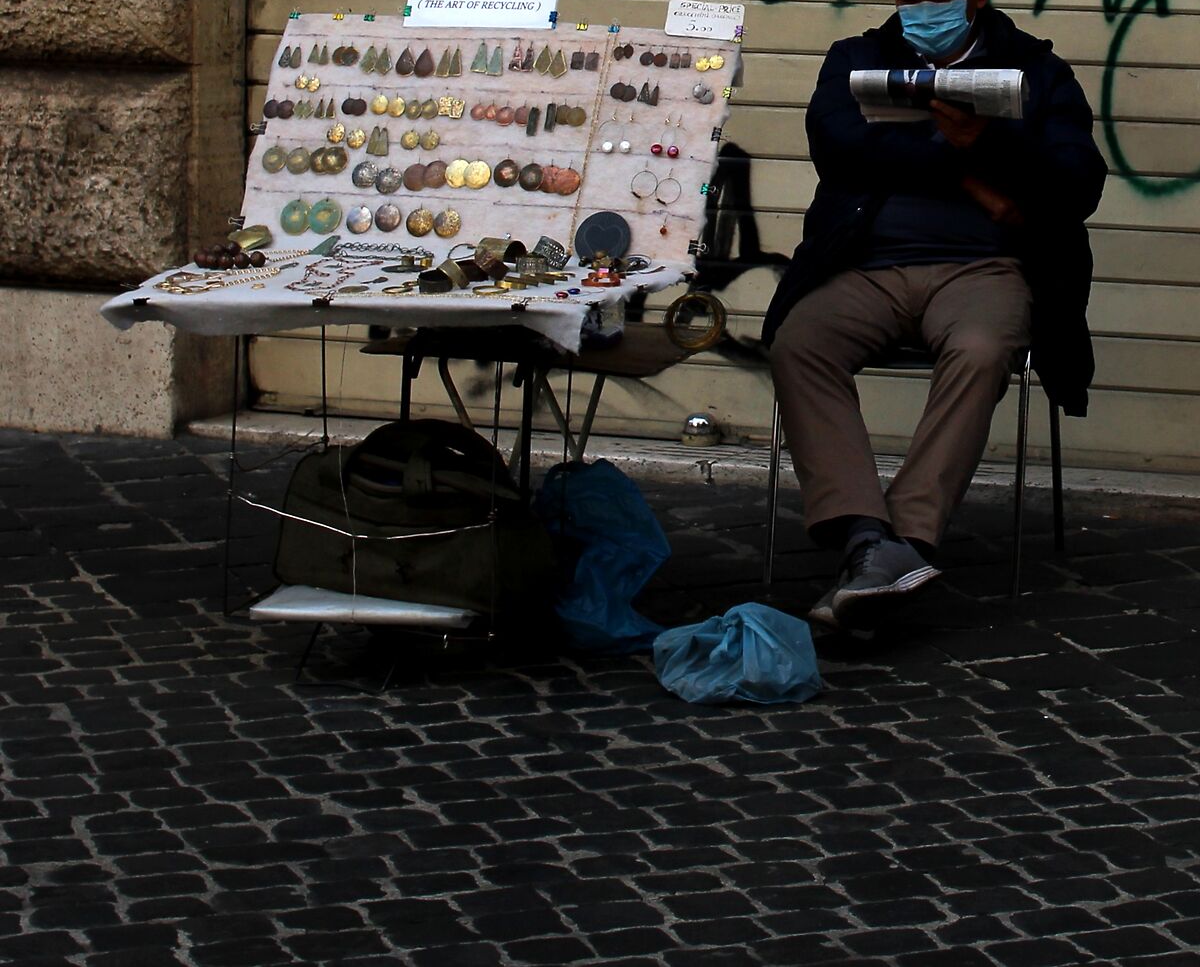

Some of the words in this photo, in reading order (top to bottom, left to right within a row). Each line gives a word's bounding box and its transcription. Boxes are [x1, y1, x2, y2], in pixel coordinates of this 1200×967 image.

[424, 0, 444, 9] THE
[445, 0, 466, 9] ART
[466, 0, 481, 9] OF
[481, 0, 535, 11] RECYCLING
[718, 4, 742, 14] PRICE
